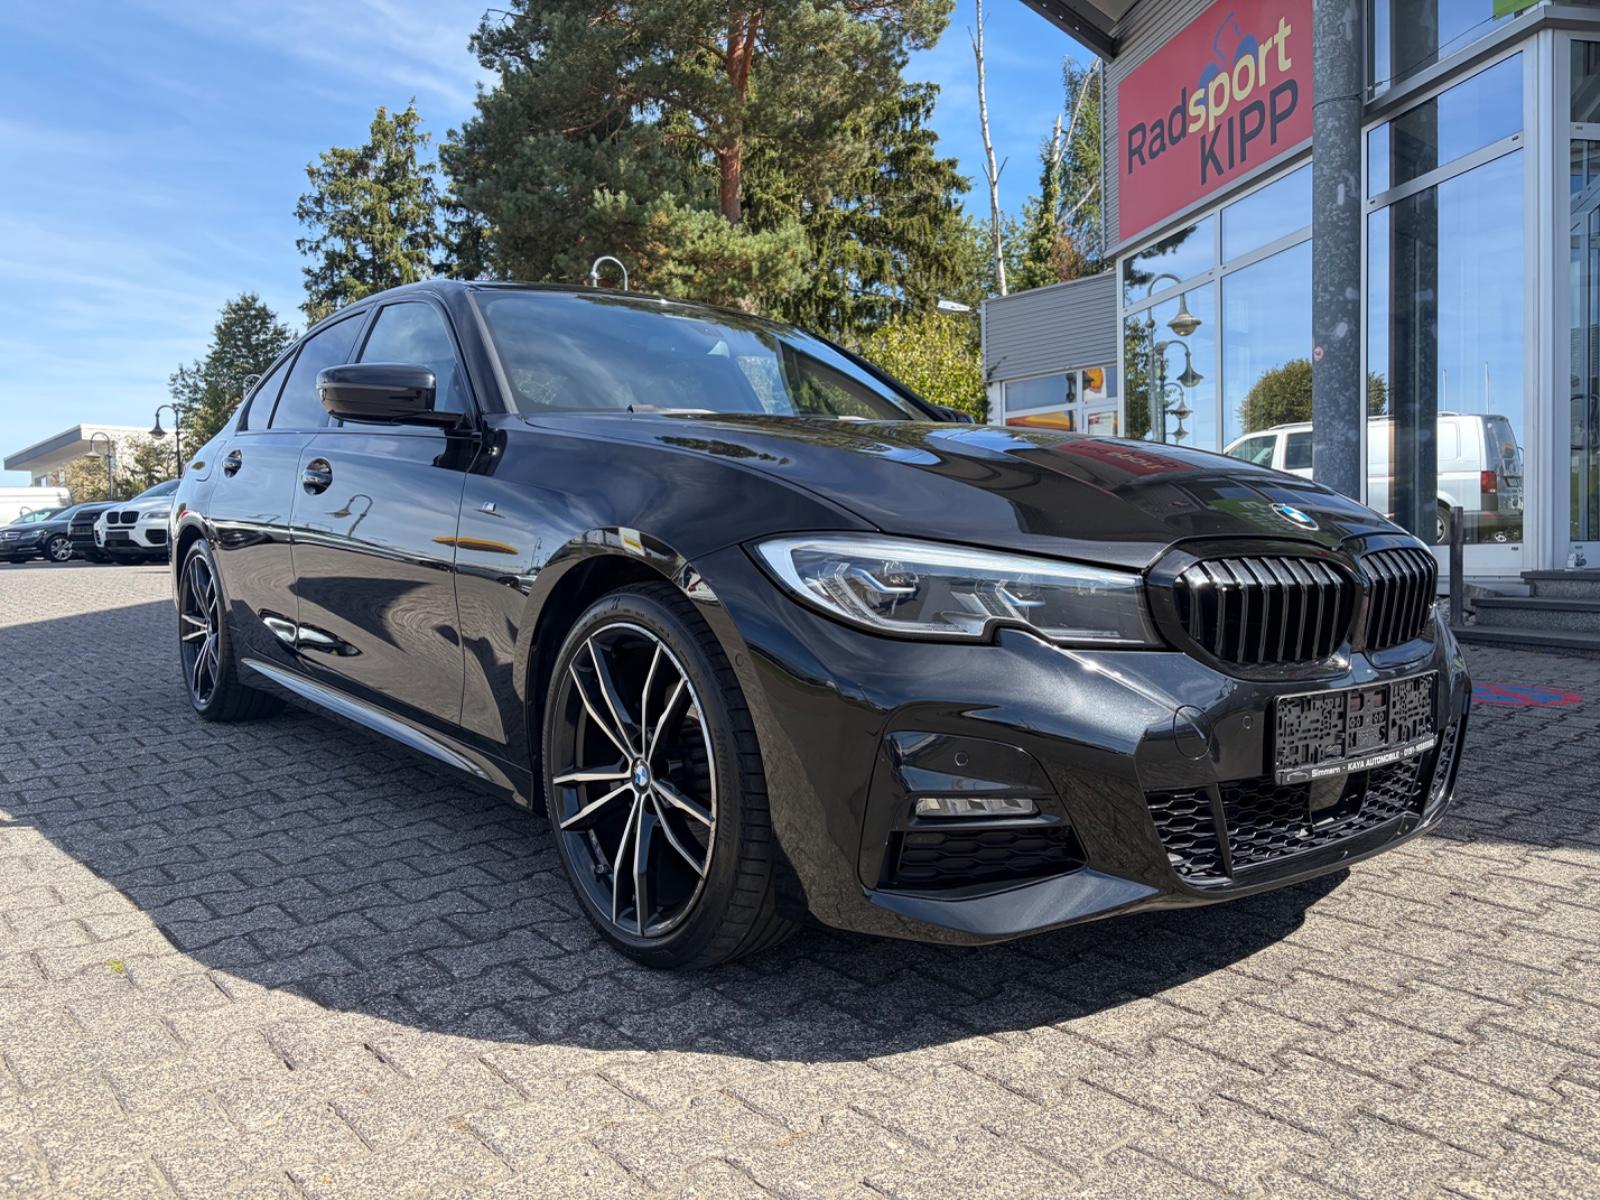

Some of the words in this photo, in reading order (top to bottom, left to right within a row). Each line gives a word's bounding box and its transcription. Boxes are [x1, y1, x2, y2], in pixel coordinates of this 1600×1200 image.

[1127, 16, 1292, 175] Radsport
[1200, 78, 1298, 186] KIPP
[714, 727, 733, 849] BRIDGESTONE
[1311, 767, 1340, 777] Simmern
[1347, 761, 1365, 771] KAYA
[1366, 752, 1400, 766] AUTOMOBILE
